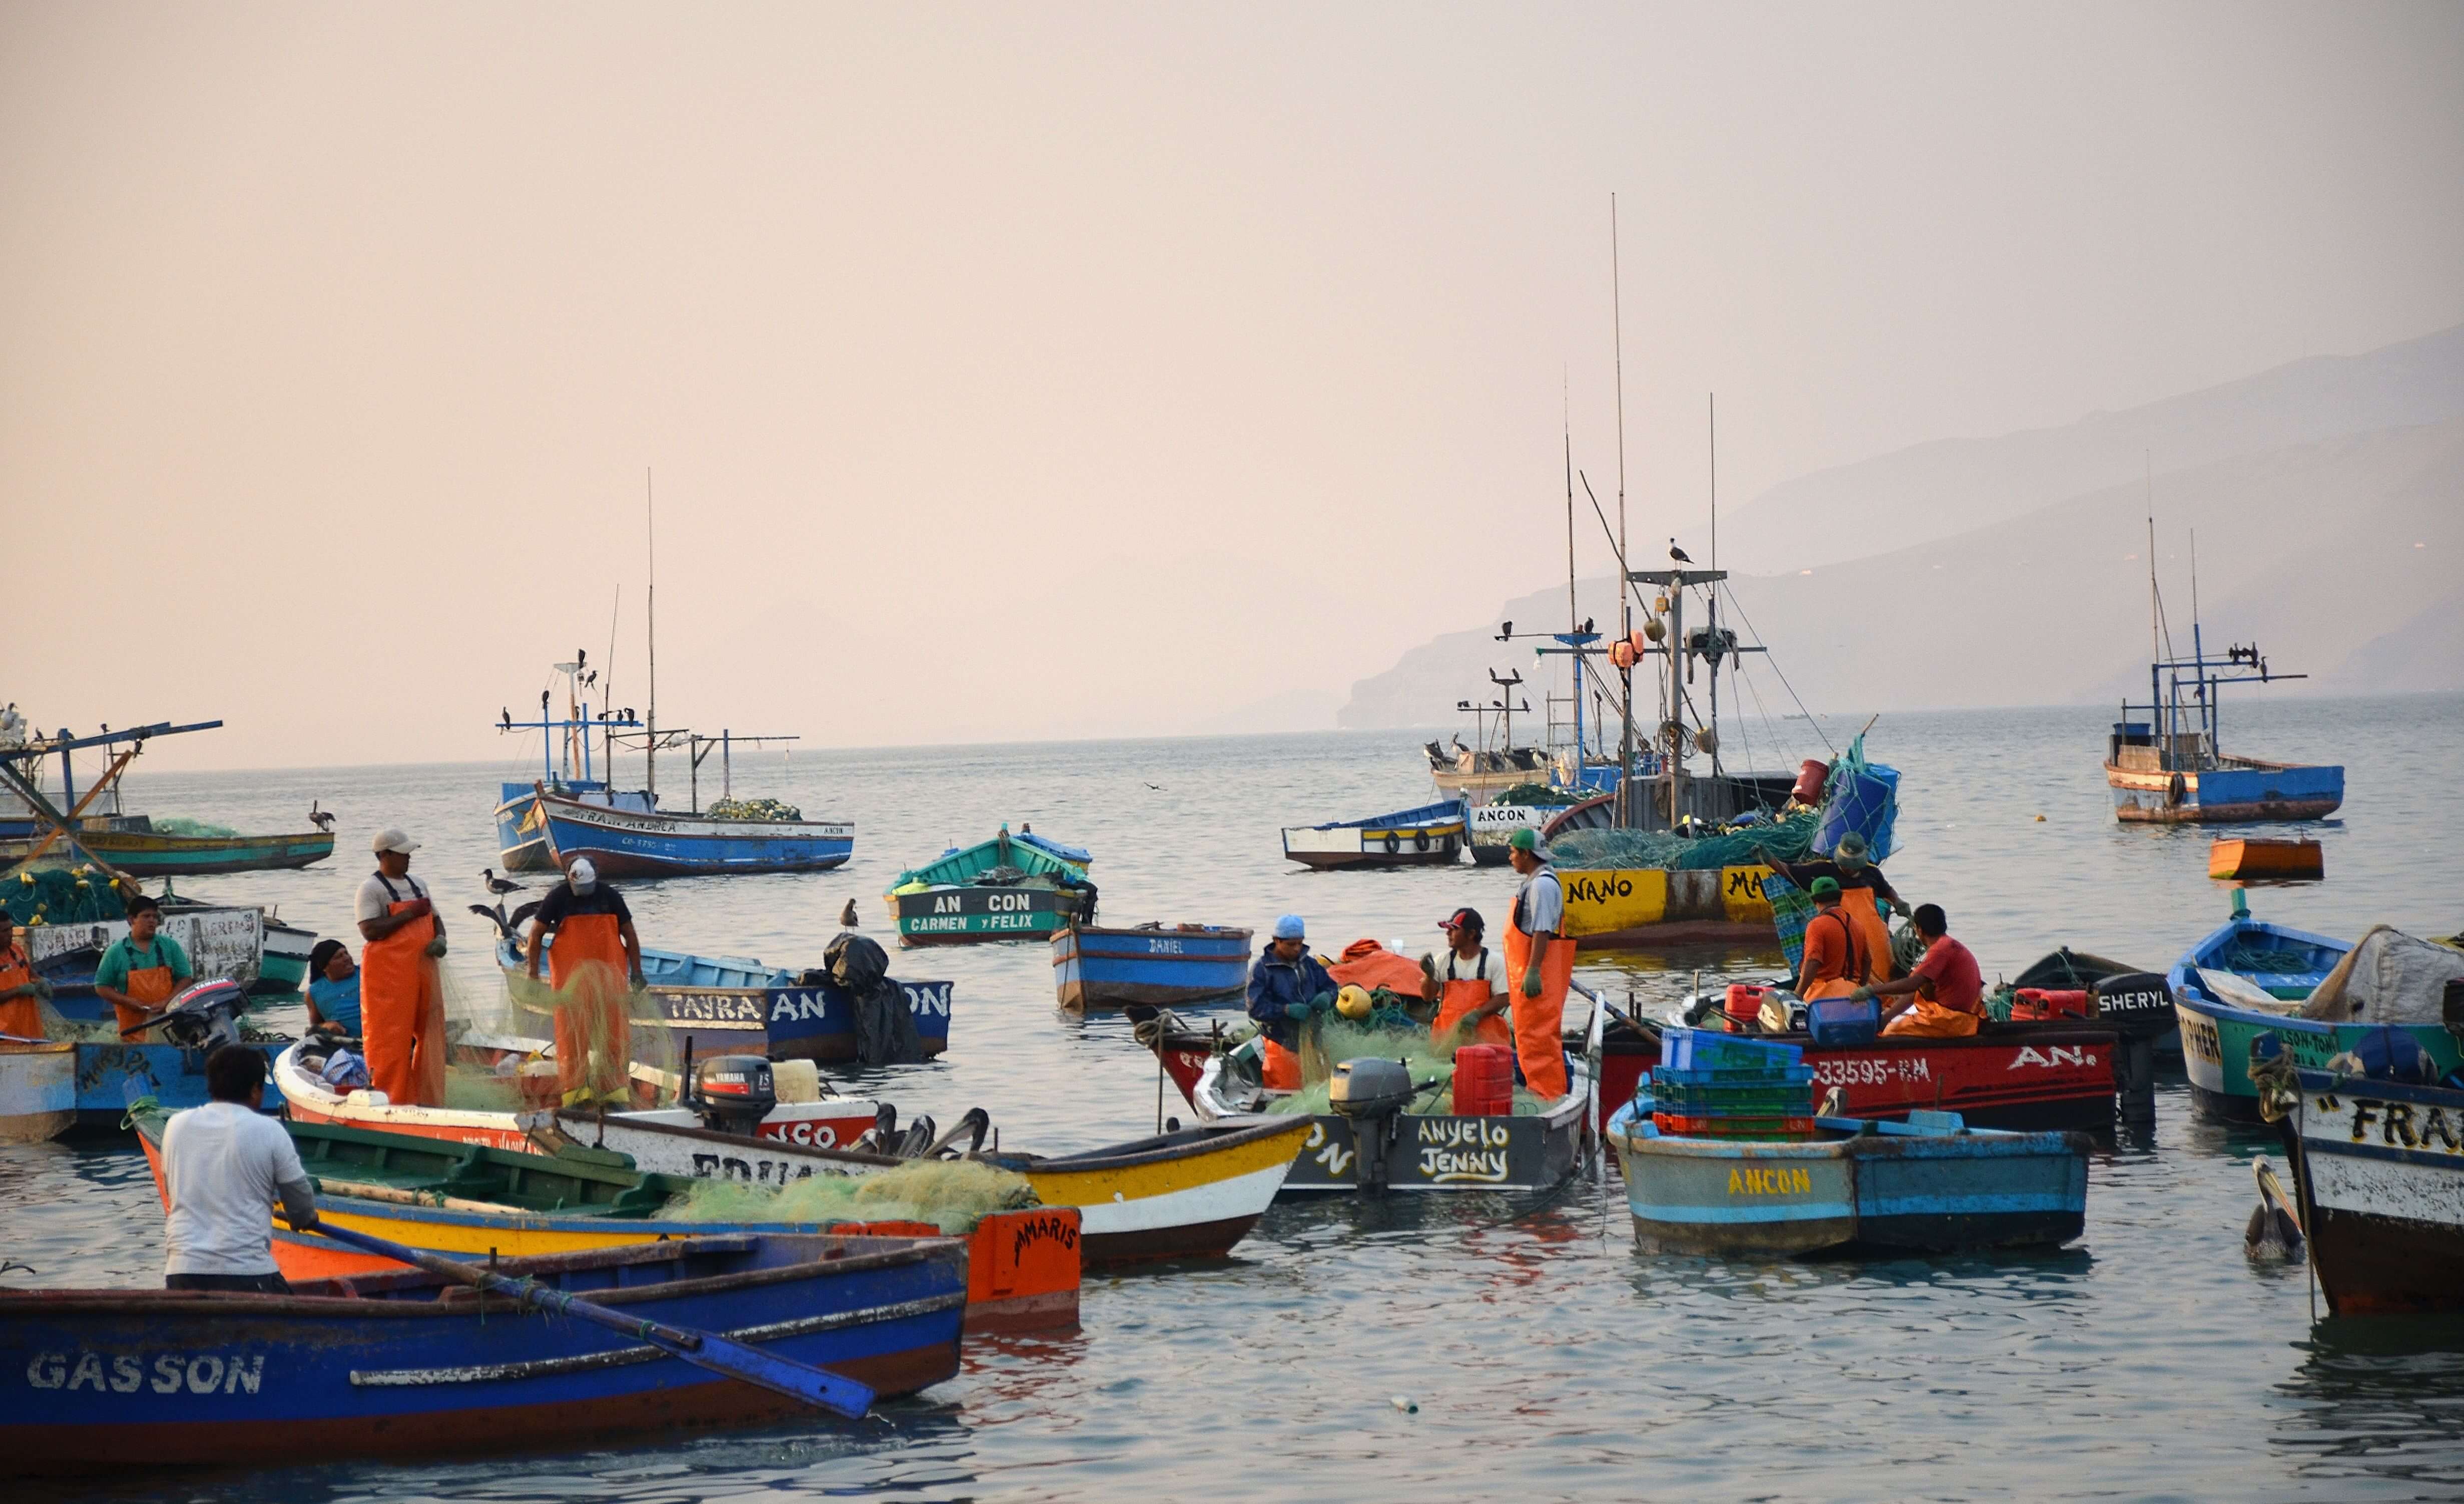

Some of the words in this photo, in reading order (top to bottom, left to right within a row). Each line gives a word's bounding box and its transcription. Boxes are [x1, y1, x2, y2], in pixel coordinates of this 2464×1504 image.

[1477, 809, 1526, 822] ANCON
[1566, 873, 1633, 904] NANO
[934, 895, 961, 913] AN
[988, 894, 1030, 912] CON
[910, 917, 967, 931] CARMEN
[990, 914, 1033, 929] FELIX
[1149, 938, 1184, 954] DANIEL
[771, 991, 825, 1021] AN
[2099, 990, 2169, 1012] SHERYL
[716, 1073, 745, 1083] YAMAHA
[759, 1073, 770, 1086] 15
[1413, 1148, 1507, 1183] JENNY
[1728, 1169, 1811, 1194] ANCON
[27, 1351, 265, 1394] GASSON
